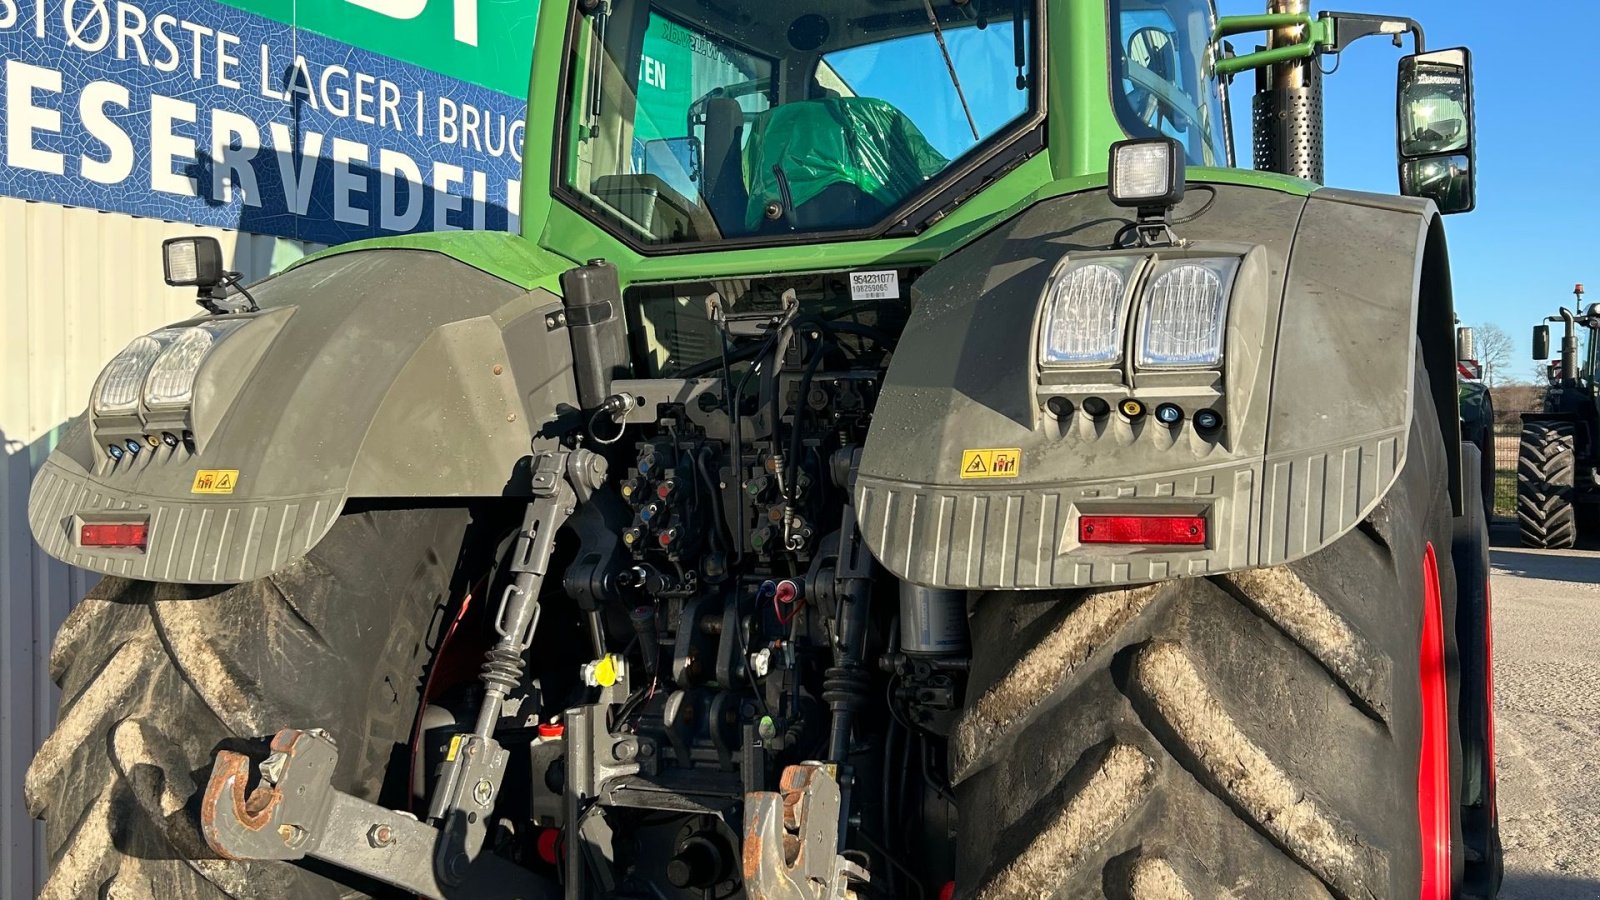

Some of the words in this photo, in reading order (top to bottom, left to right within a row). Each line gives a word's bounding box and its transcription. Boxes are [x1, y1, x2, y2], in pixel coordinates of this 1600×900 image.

[260, 43, 402, 131] LAGER
[417, 90, 424, 137] I
[853, 273, 895, 285] 954231077
